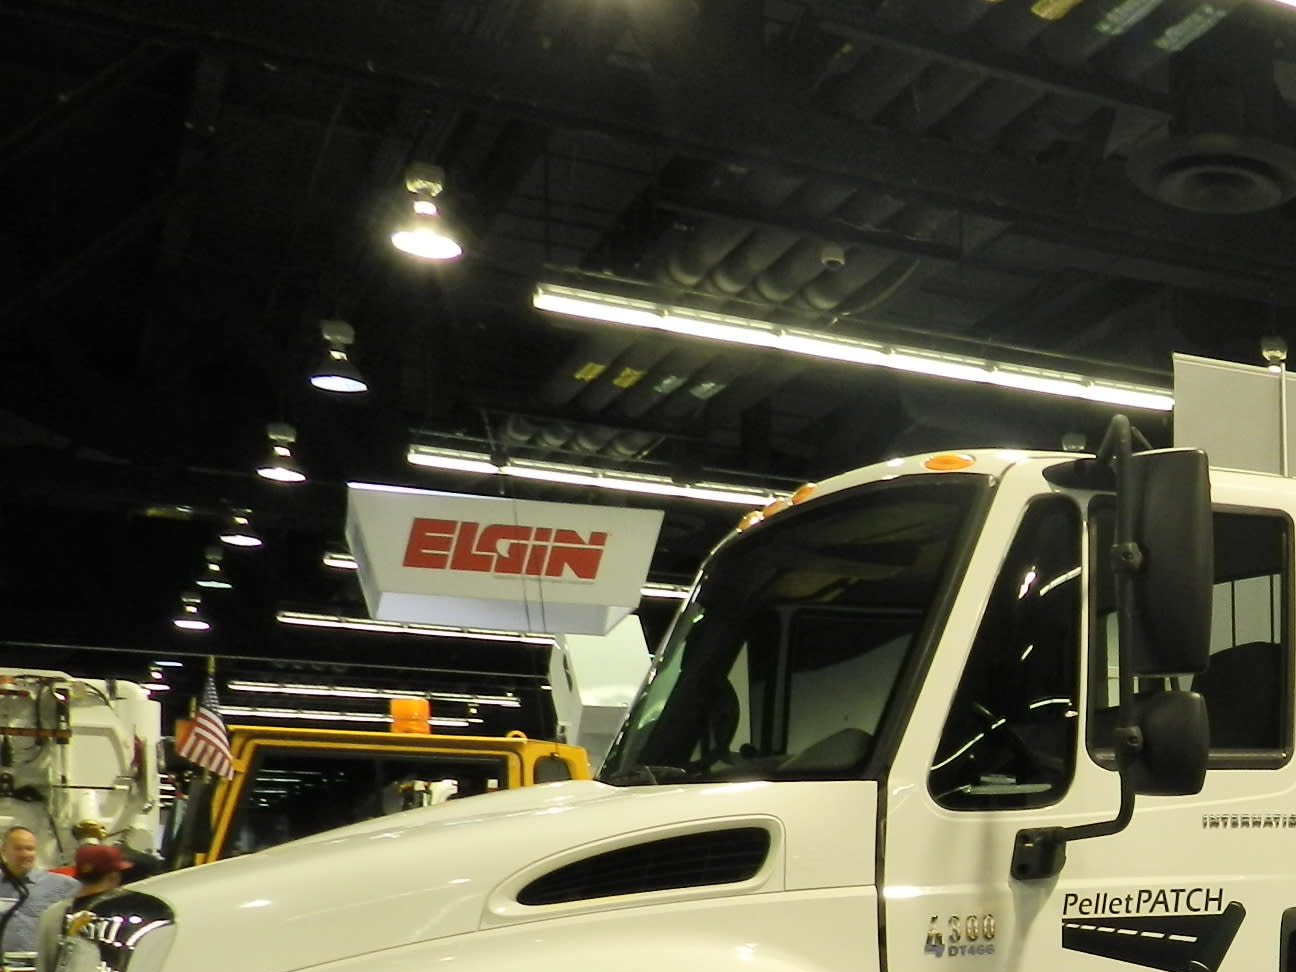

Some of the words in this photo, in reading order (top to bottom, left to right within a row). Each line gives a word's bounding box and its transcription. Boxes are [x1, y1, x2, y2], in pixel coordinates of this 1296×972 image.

[402, 517, 609, 580] ELGIN
[1063, 888, 1223, 915] PelletPATCH
[924, 914, 995, 958] 4300
